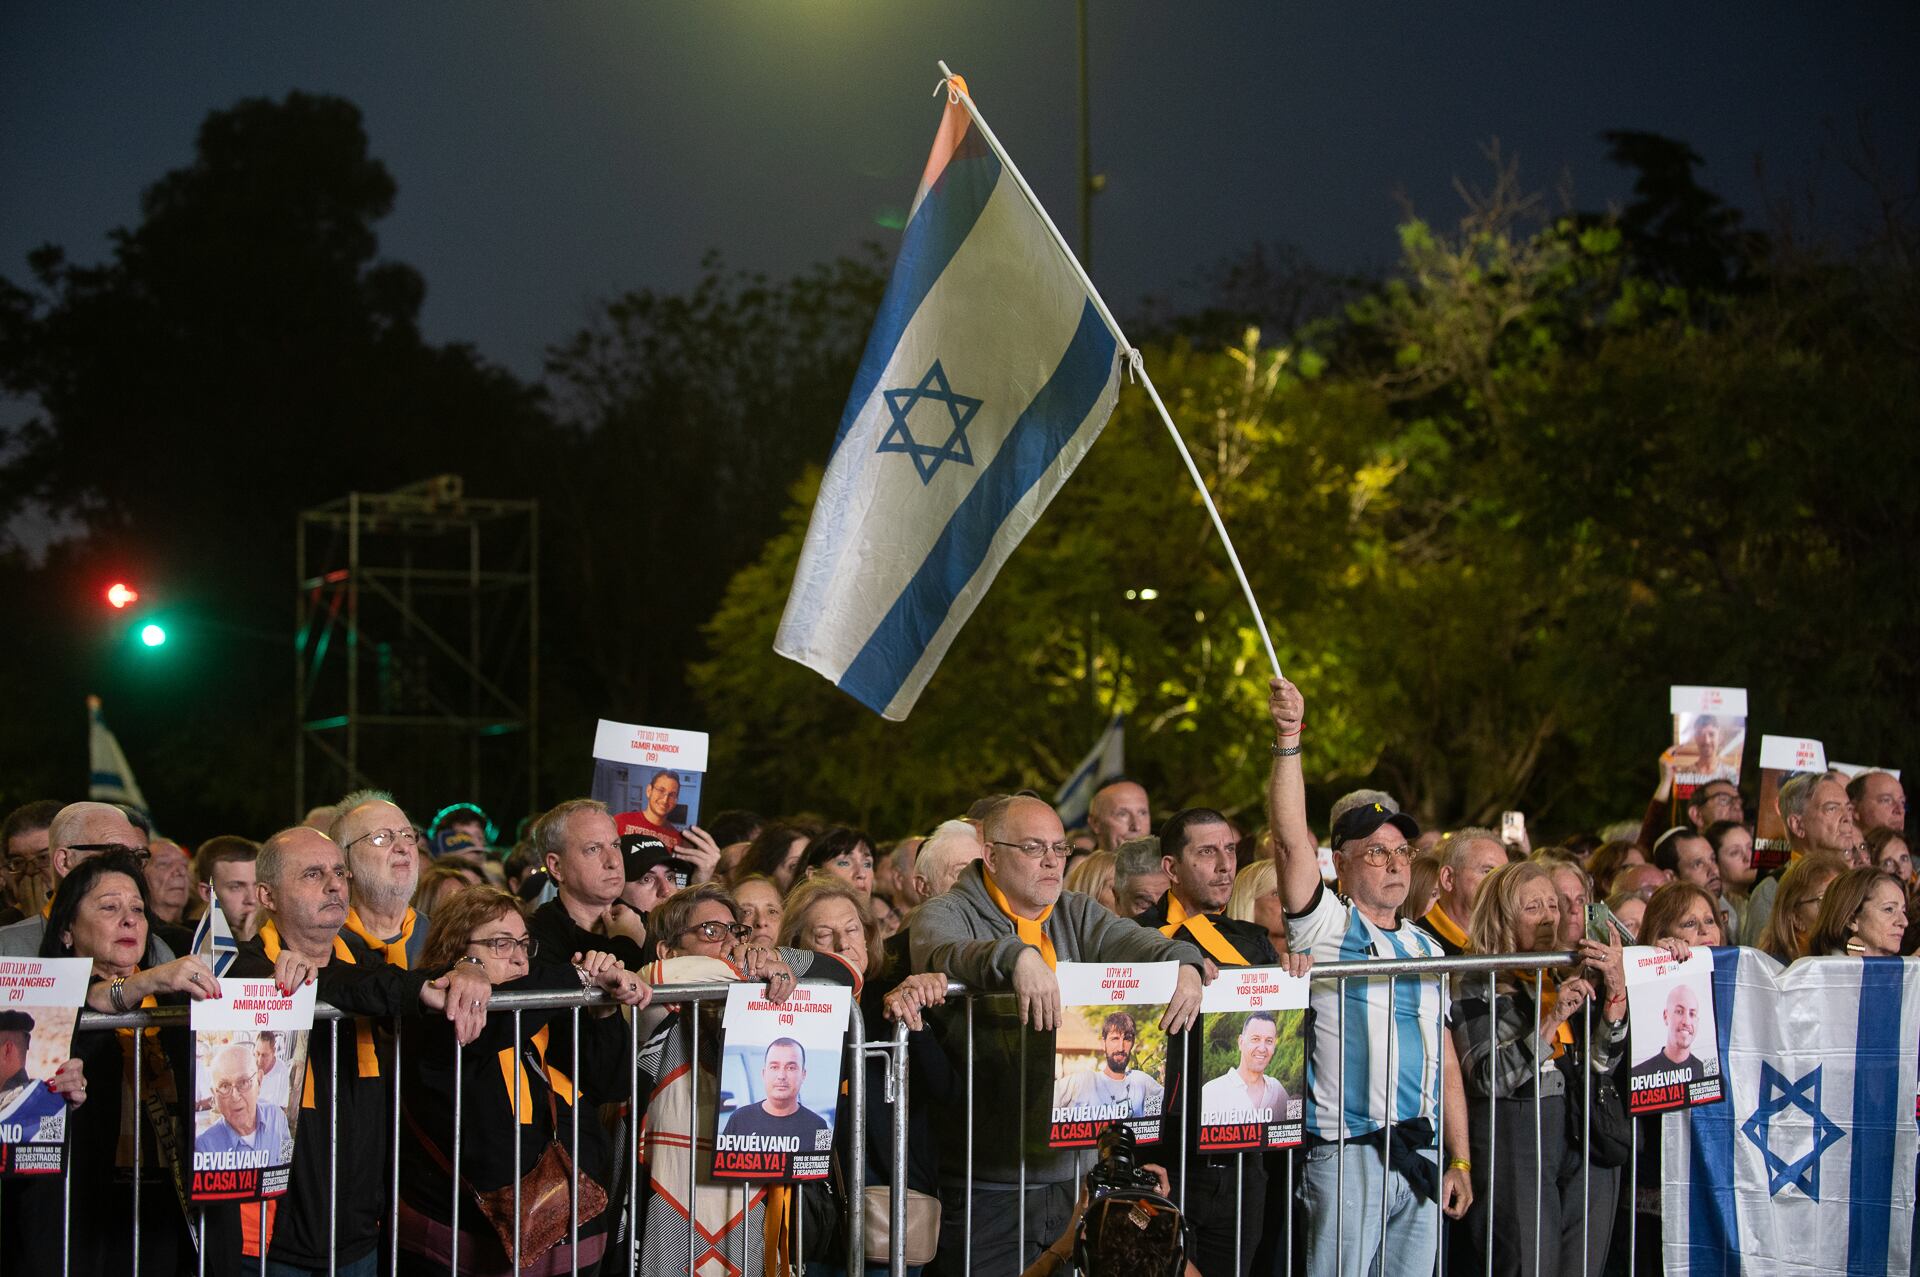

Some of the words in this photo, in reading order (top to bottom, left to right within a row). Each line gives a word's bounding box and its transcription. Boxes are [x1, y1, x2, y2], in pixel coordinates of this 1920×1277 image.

[631, 741, 651, 751] TAMIR
[645, 752, 659, 762] (19)
[1638, 958, 1653, 968] EITAN
[0, 977, 18, 987] TAN
[18, 977, 56, 988] ANGREST
[1101, 979, 1117, 989] GUY
[1117, 979, 1140, 989] ILLOUZ
[9, 989, 25, 1001] (21)
[1111, 990, 1126, 1001] (26)
[1236, 986, 1251, 995] YOSI
[1252, 984, 1280, 995] SHARABI
[233, 999, 266, 1010] AMIRAM
[267, 999, 293, 1010] COOPER
[1249, 995, 1263, 1007] (53)
[747, 1001, 793, 1012] MUHAMMAD
[793, 1002, 833, 1014] AL-ATRASH
[254, 1013, 270, 1026] (85)
[778, 1014, 794, 1026] (40)
[1631, 1067, 1692, 1091] DEVUÉLVANLO
[1631, 1091, 1639, 1106] A
[1640, 1088, 1667, 1105] CASA
[1667, 1083, 1685, 1100] YA!
[1052, 1100, 1129, 1123] DEVUÉLVANLO
[1201, 1107, 1273, 1126] DEVUÉLVANLO
[1050, 1124, 1060, 1140] A
[1061, 1121, 1093, 1139] CASA
[1200, 1127, 1209, 1142] A
[1210, 1126, 1241, 1142] CASA
[1241, 1123, 1262, 1141] YA!
[716, 1132, 800, 1153] DEVUÉLVANLO
[15, 1153, 62, 1162] SECUESTRADOS
[193, 1147, 270, 1171] DEVUÉLVANLO
[714, 1153, 725, 1169] A
[726, 1153, 762, 1169] CASA
[763, 1153, 787, 1171] YA!
[192, 1172, 203, 1191] A
[204, 1170, 237, 1191] CASA
[237, 1168, 259, 1190] YA!
